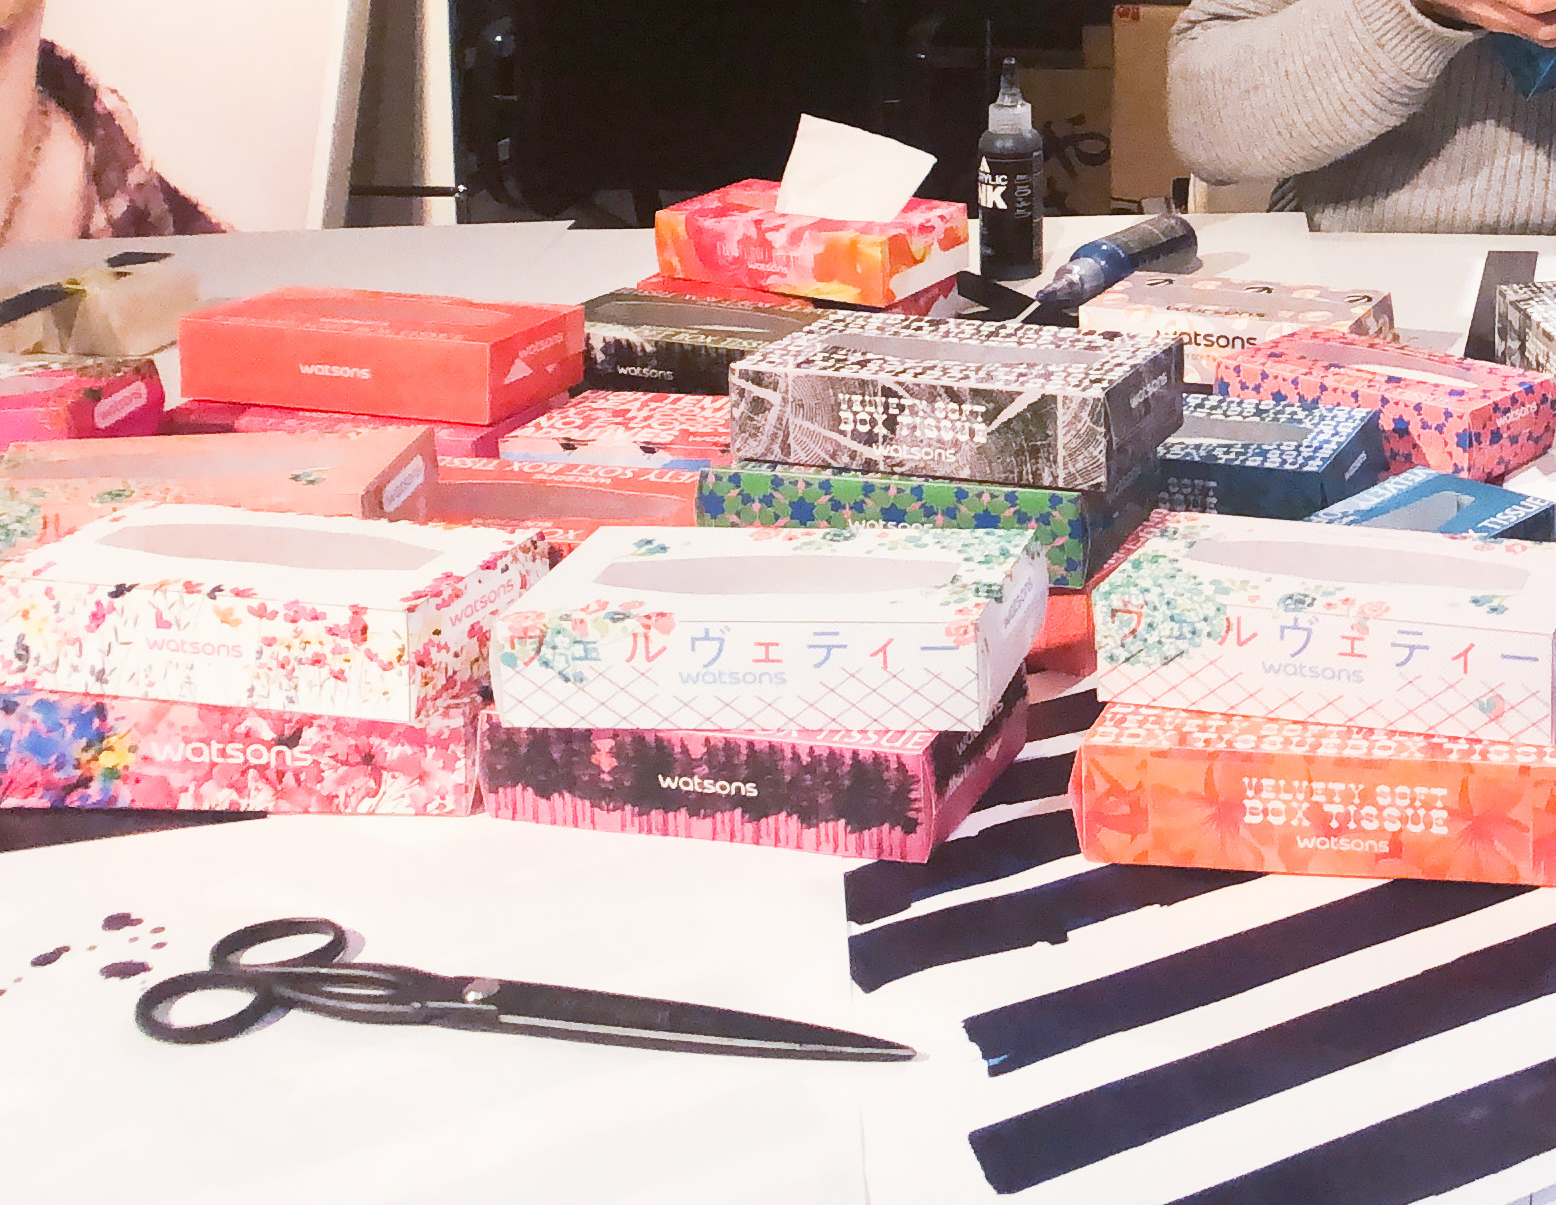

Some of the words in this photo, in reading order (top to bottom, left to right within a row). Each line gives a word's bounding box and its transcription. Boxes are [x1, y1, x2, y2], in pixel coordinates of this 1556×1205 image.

[299, 363, 372, 380] watsons
[617, 365, 675, 381] watsons
[872, 442, 957, 463] watsons
[504, 460, 558, 474] BOX
[449, 580, 515, 628] watsons
[146, 636, 244, 659] watsons
[679, 667, 788, 687] watsons
[1262, 660, 1364, 684] watsons
[151, 737, 315, 768] watsons
[658, 773, 759, 798] watsons
[1242, 777, 1366, 804] VELVETY
[1375, 783, 1449, 808] SOFT
[1243, 799, 1312, 827] BOX
[1323, 803, 1450, 835] TISSUE
[1296, 834, 1391, 854] watsons
